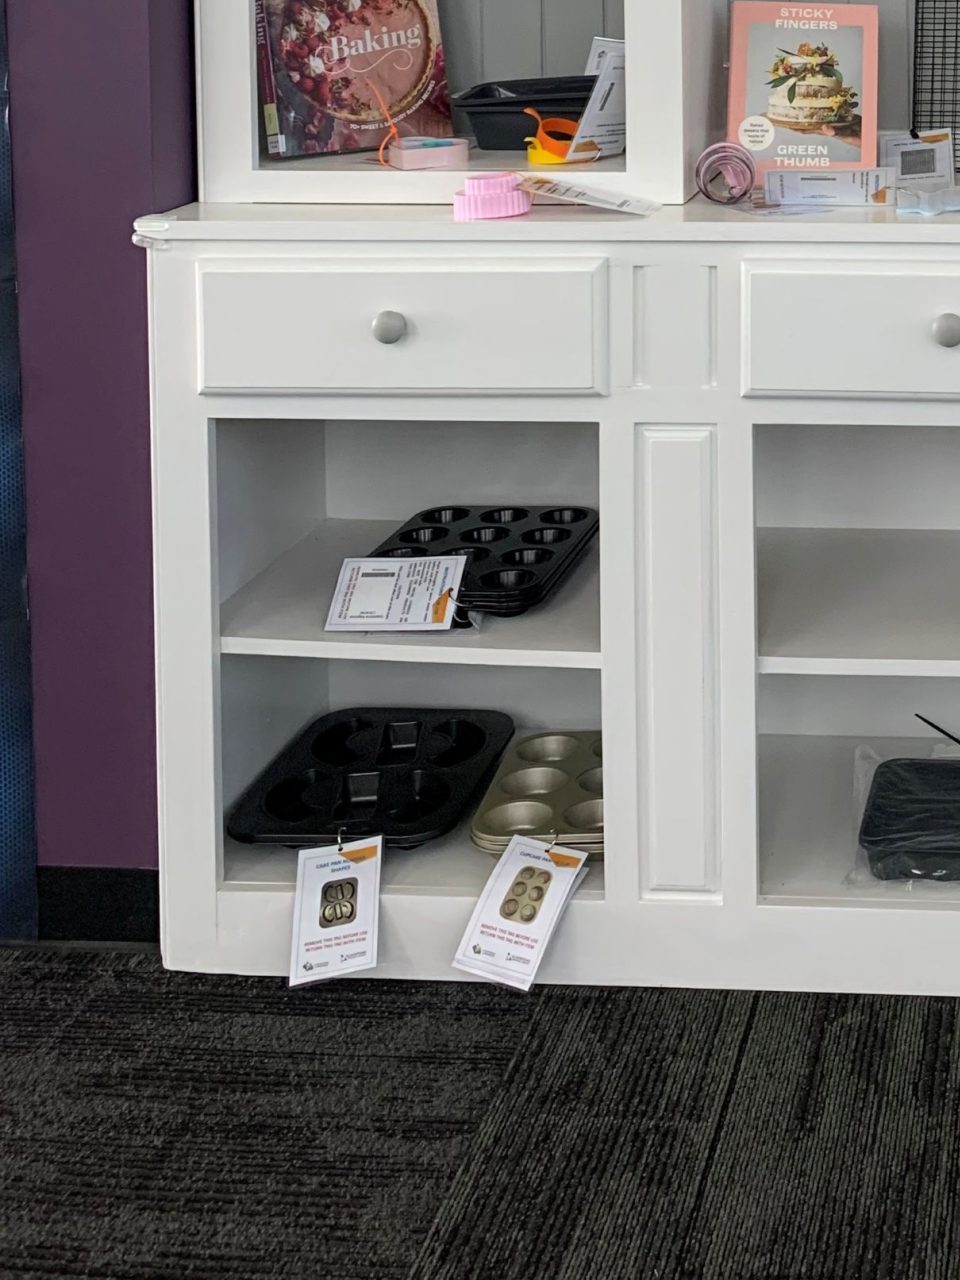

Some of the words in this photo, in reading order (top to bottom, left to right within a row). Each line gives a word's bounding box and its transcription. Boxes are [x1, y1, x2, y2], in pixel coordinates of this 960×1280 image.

[780, 7, 834, 19] STICKY
[775, 19, 838, 31] FINGERS
[325, 23, 421, 62] Baking
[776, 144, 828, 155] GREEN
[774, 156, 830, 167] THUMB
